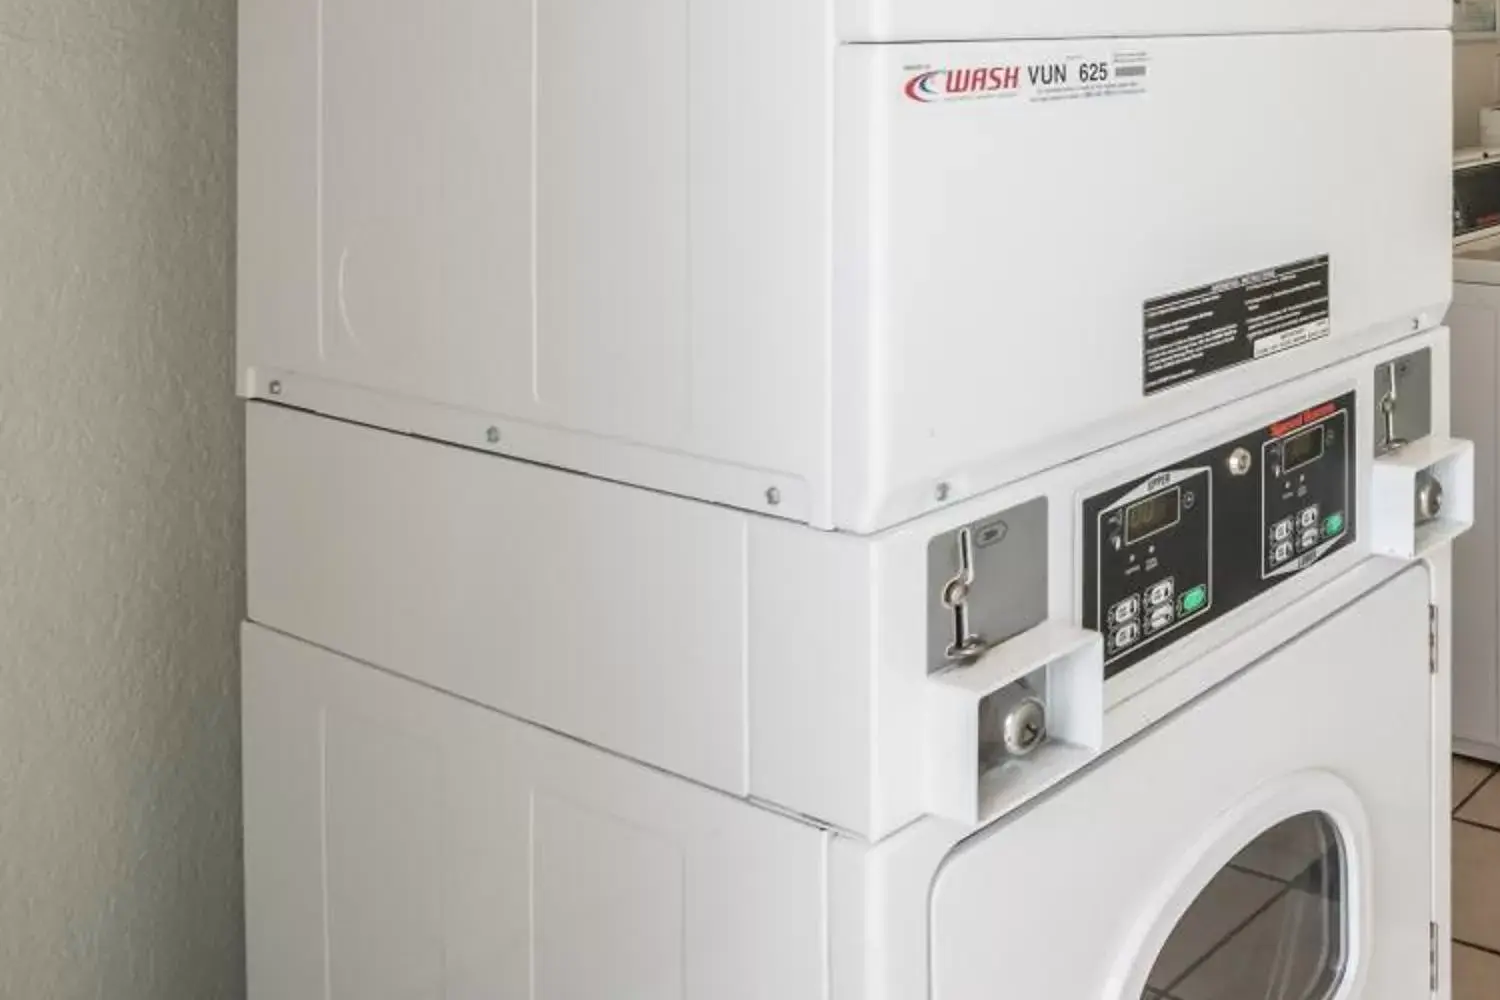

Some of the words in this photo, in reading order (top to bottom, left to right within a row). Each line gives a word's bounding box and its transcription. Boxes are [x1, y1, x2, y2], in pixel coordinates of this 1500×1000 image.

[945, 66, 1020, 93] WASH
[1028, 62, 1066, 85] VUN
[1079, 62, 1108, 82] 625
